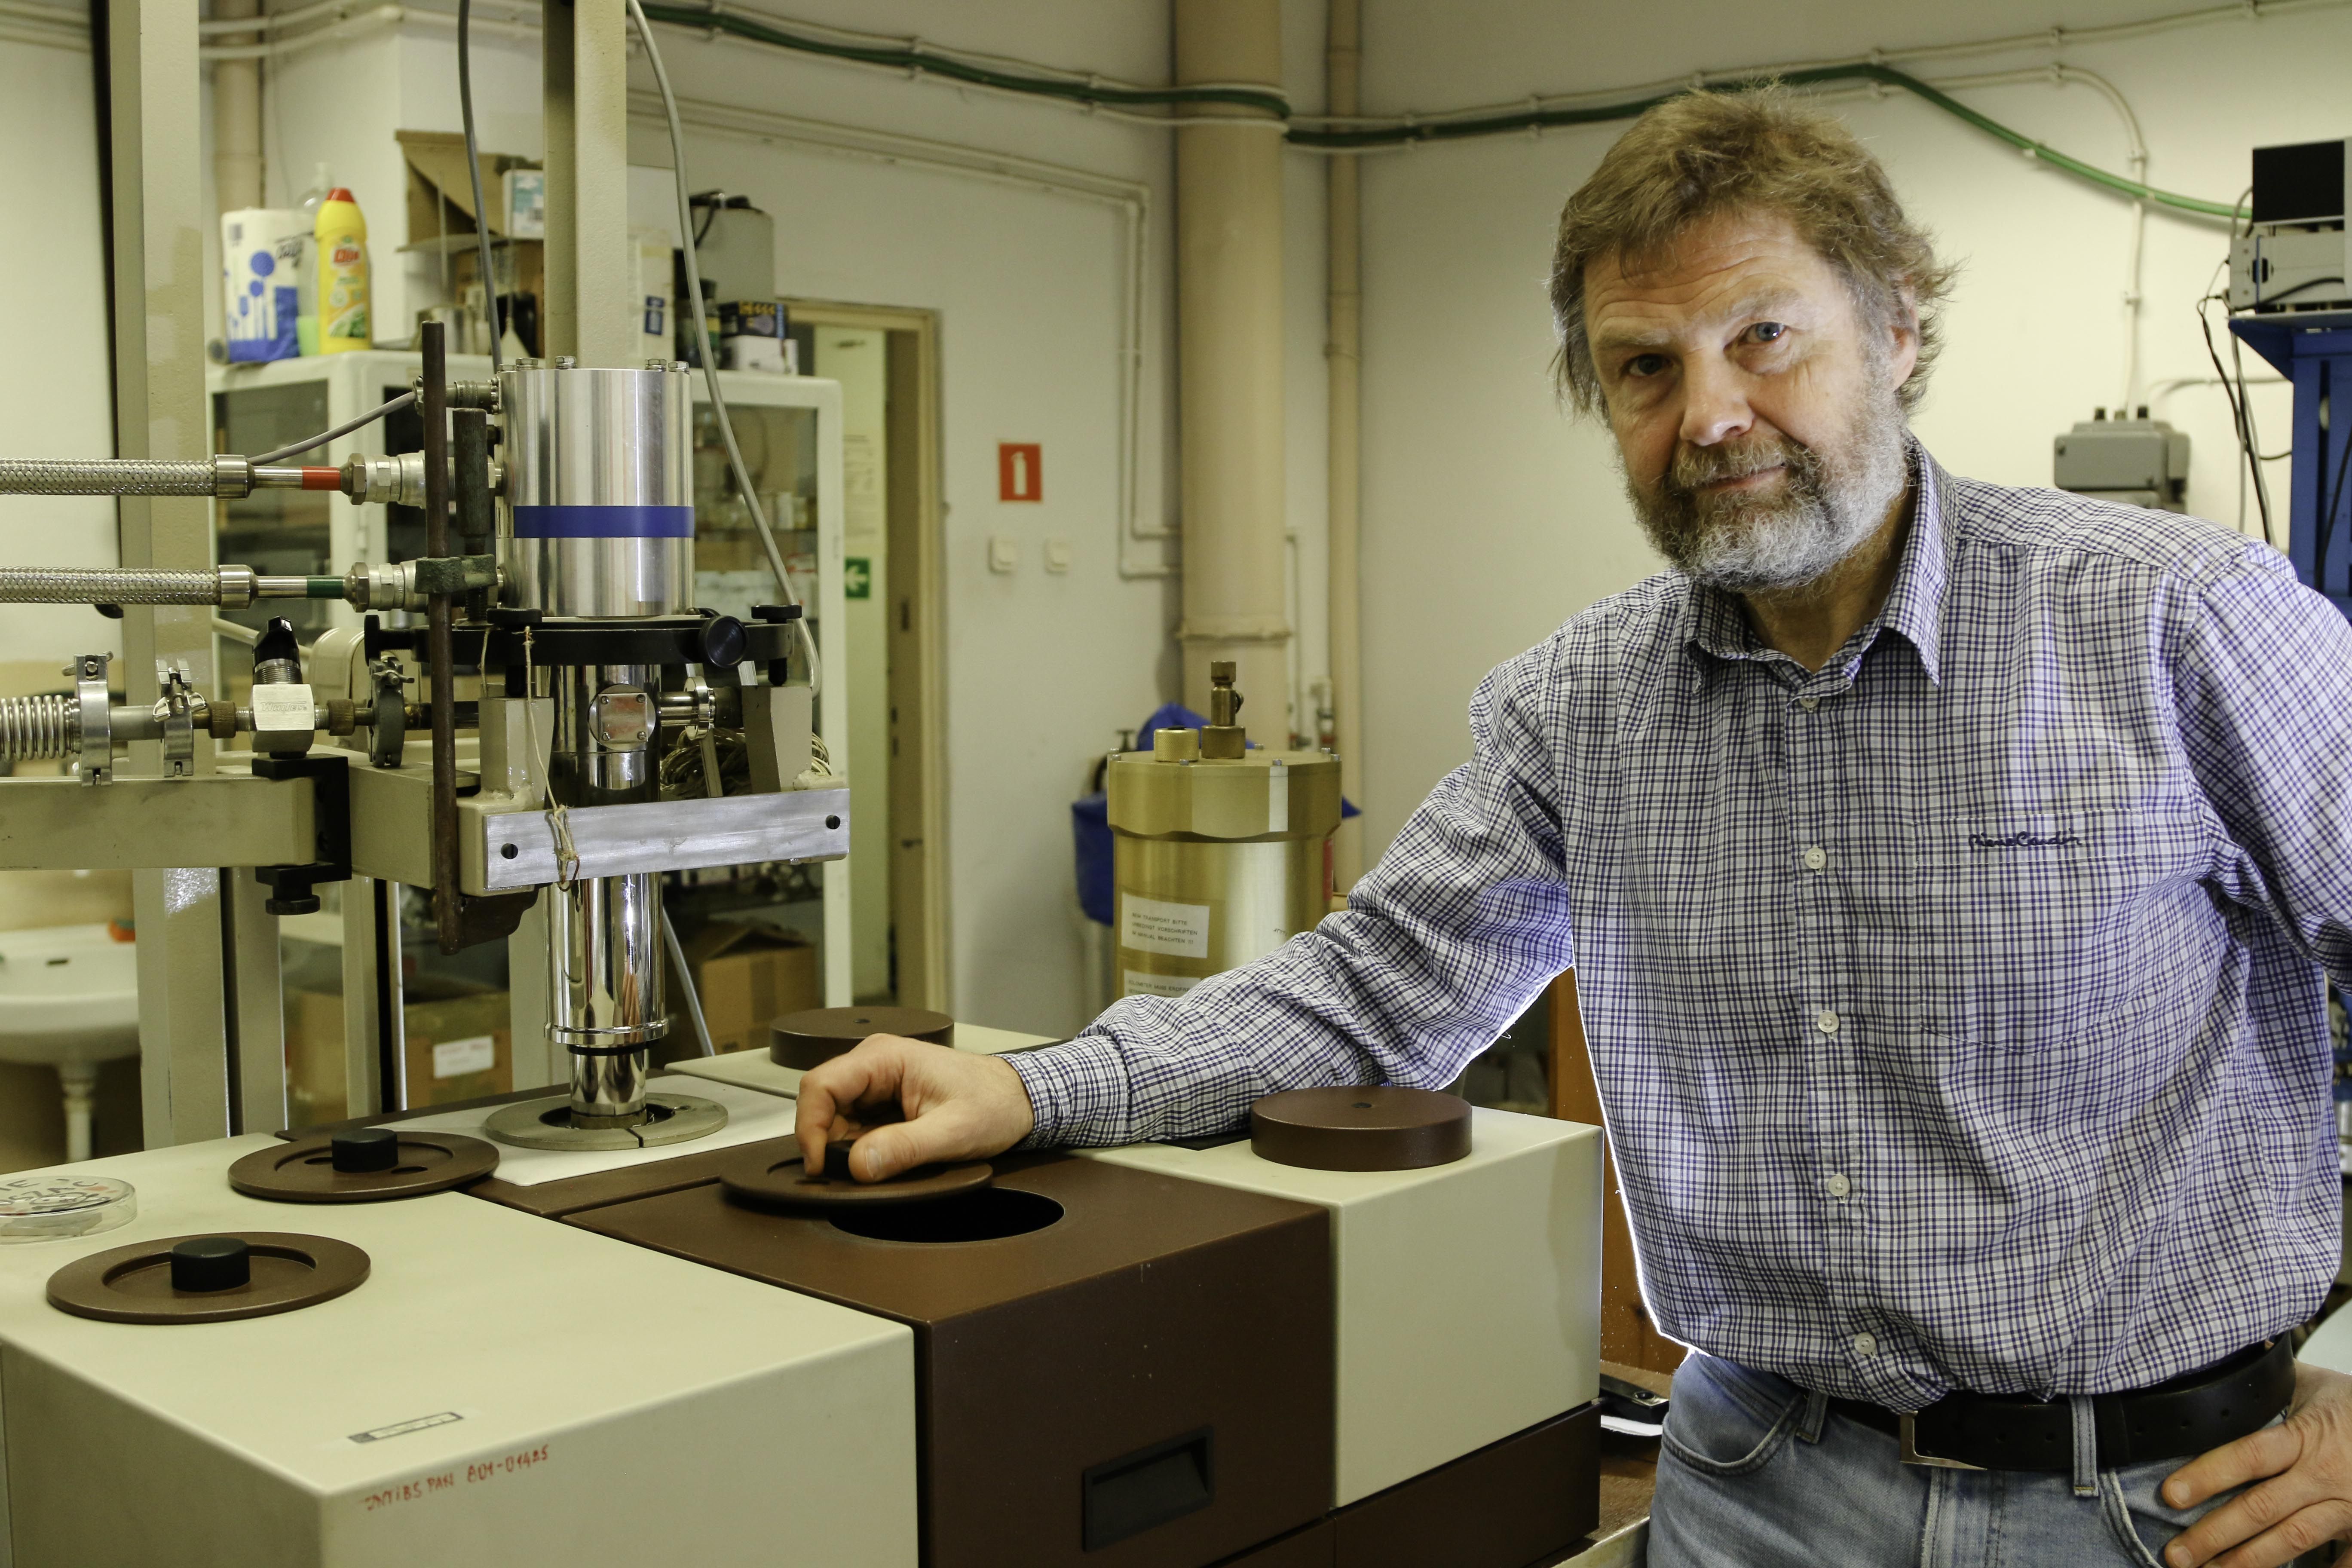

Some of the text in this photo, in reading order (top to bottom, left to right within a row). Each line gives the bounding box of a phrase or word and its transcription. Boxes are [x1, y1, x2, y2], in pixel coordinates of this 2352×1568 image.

[1143, 914, 1170, 923] TRANSPORT
[1158, 926, 1198, 936] VORSCHRIFTEN
[1158, 936, 1185, 944] BEACHTEN
